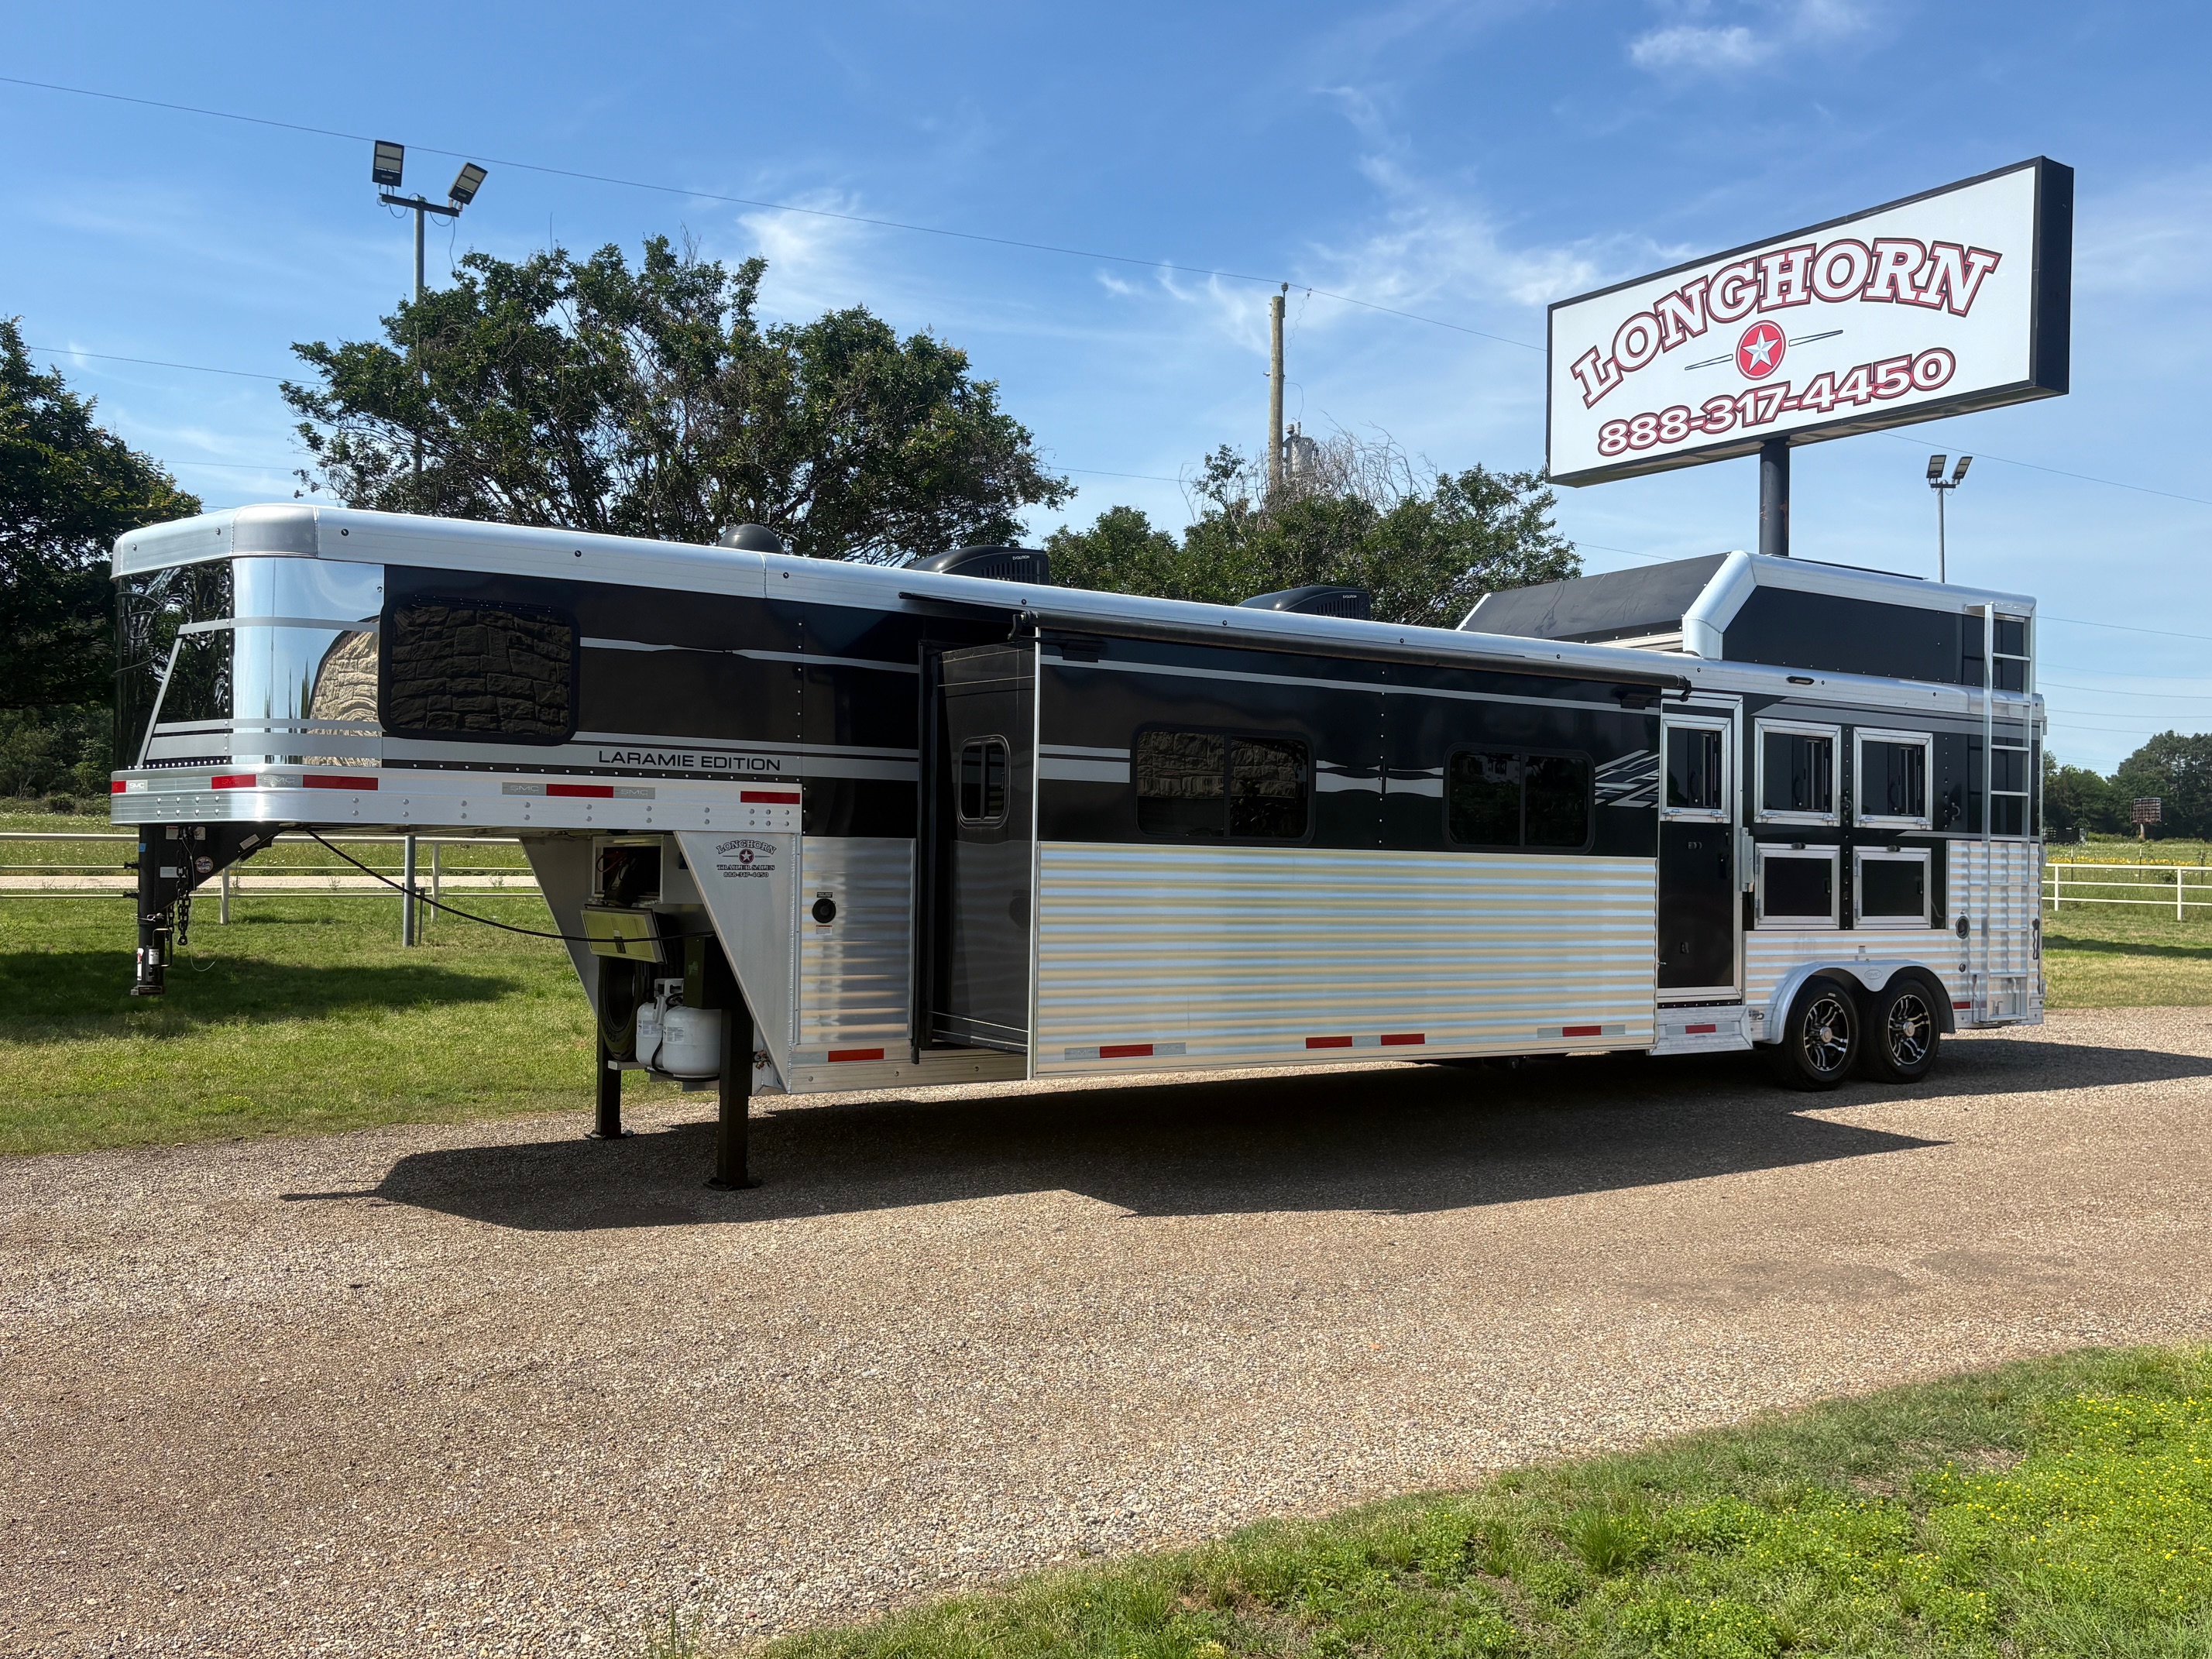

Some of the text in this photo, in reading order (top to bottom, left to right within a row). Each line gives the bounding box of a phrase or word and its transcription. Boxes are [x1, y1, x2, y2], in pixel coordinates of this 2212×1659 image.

[1571, 237, 2002, 410] LONGHORN
[1597, 347, 1956, 457] 888-317-4450
[599, 750, 781, 771] LARAMIE EDITION
[716, 839, 777, 854] LONGHORN
